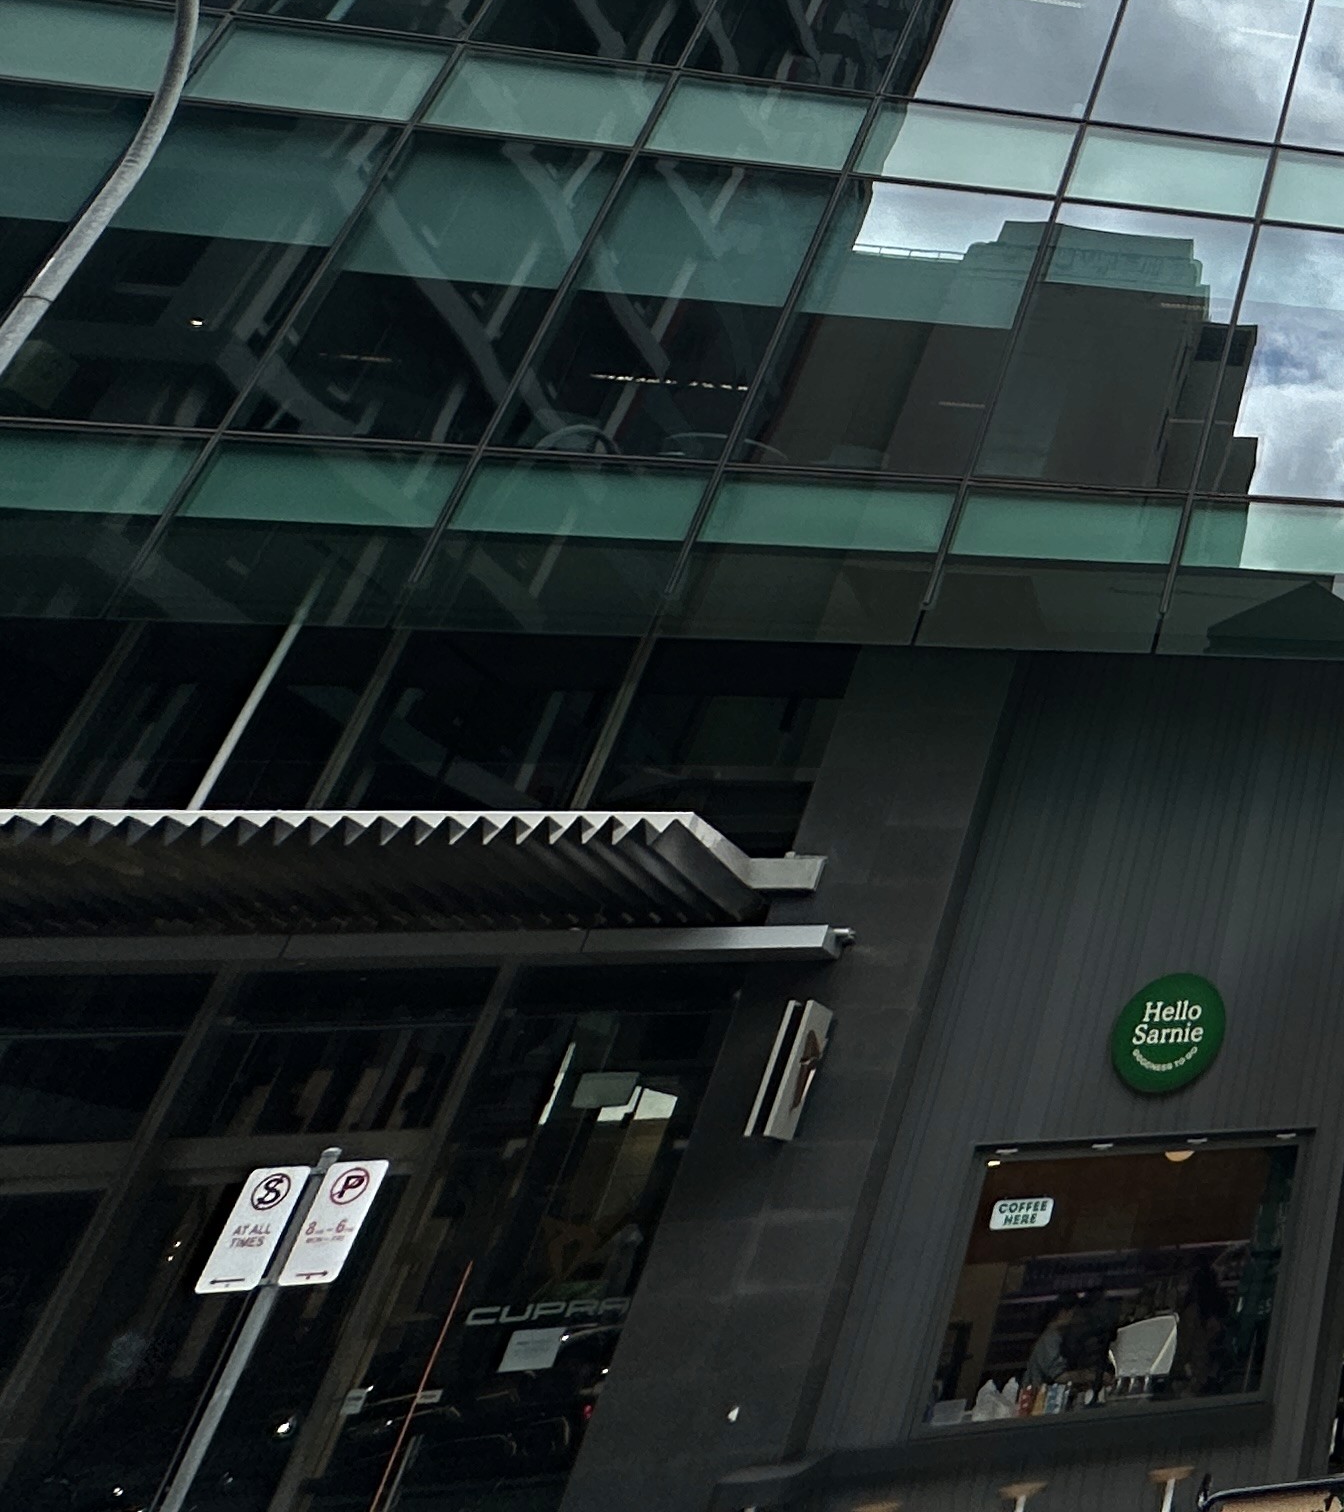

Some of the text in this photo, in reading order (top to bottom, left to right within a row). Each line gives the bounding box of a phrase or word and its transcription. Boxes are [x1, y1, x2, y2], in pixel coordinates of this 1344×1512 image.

[1142, 1000, 1203, 1022] Hello
[1132, 1022, 1204, 1045] Sarnie
[998, 1200, 1049, 1214] COFFEE
[1003, 1213, 1038, 1226] HERE
[232, 1223, 271, 1236] AT ALL
[230, 1237, 264, 1248] TIMES
[466, 1296, 631, 1326] CUPRA
